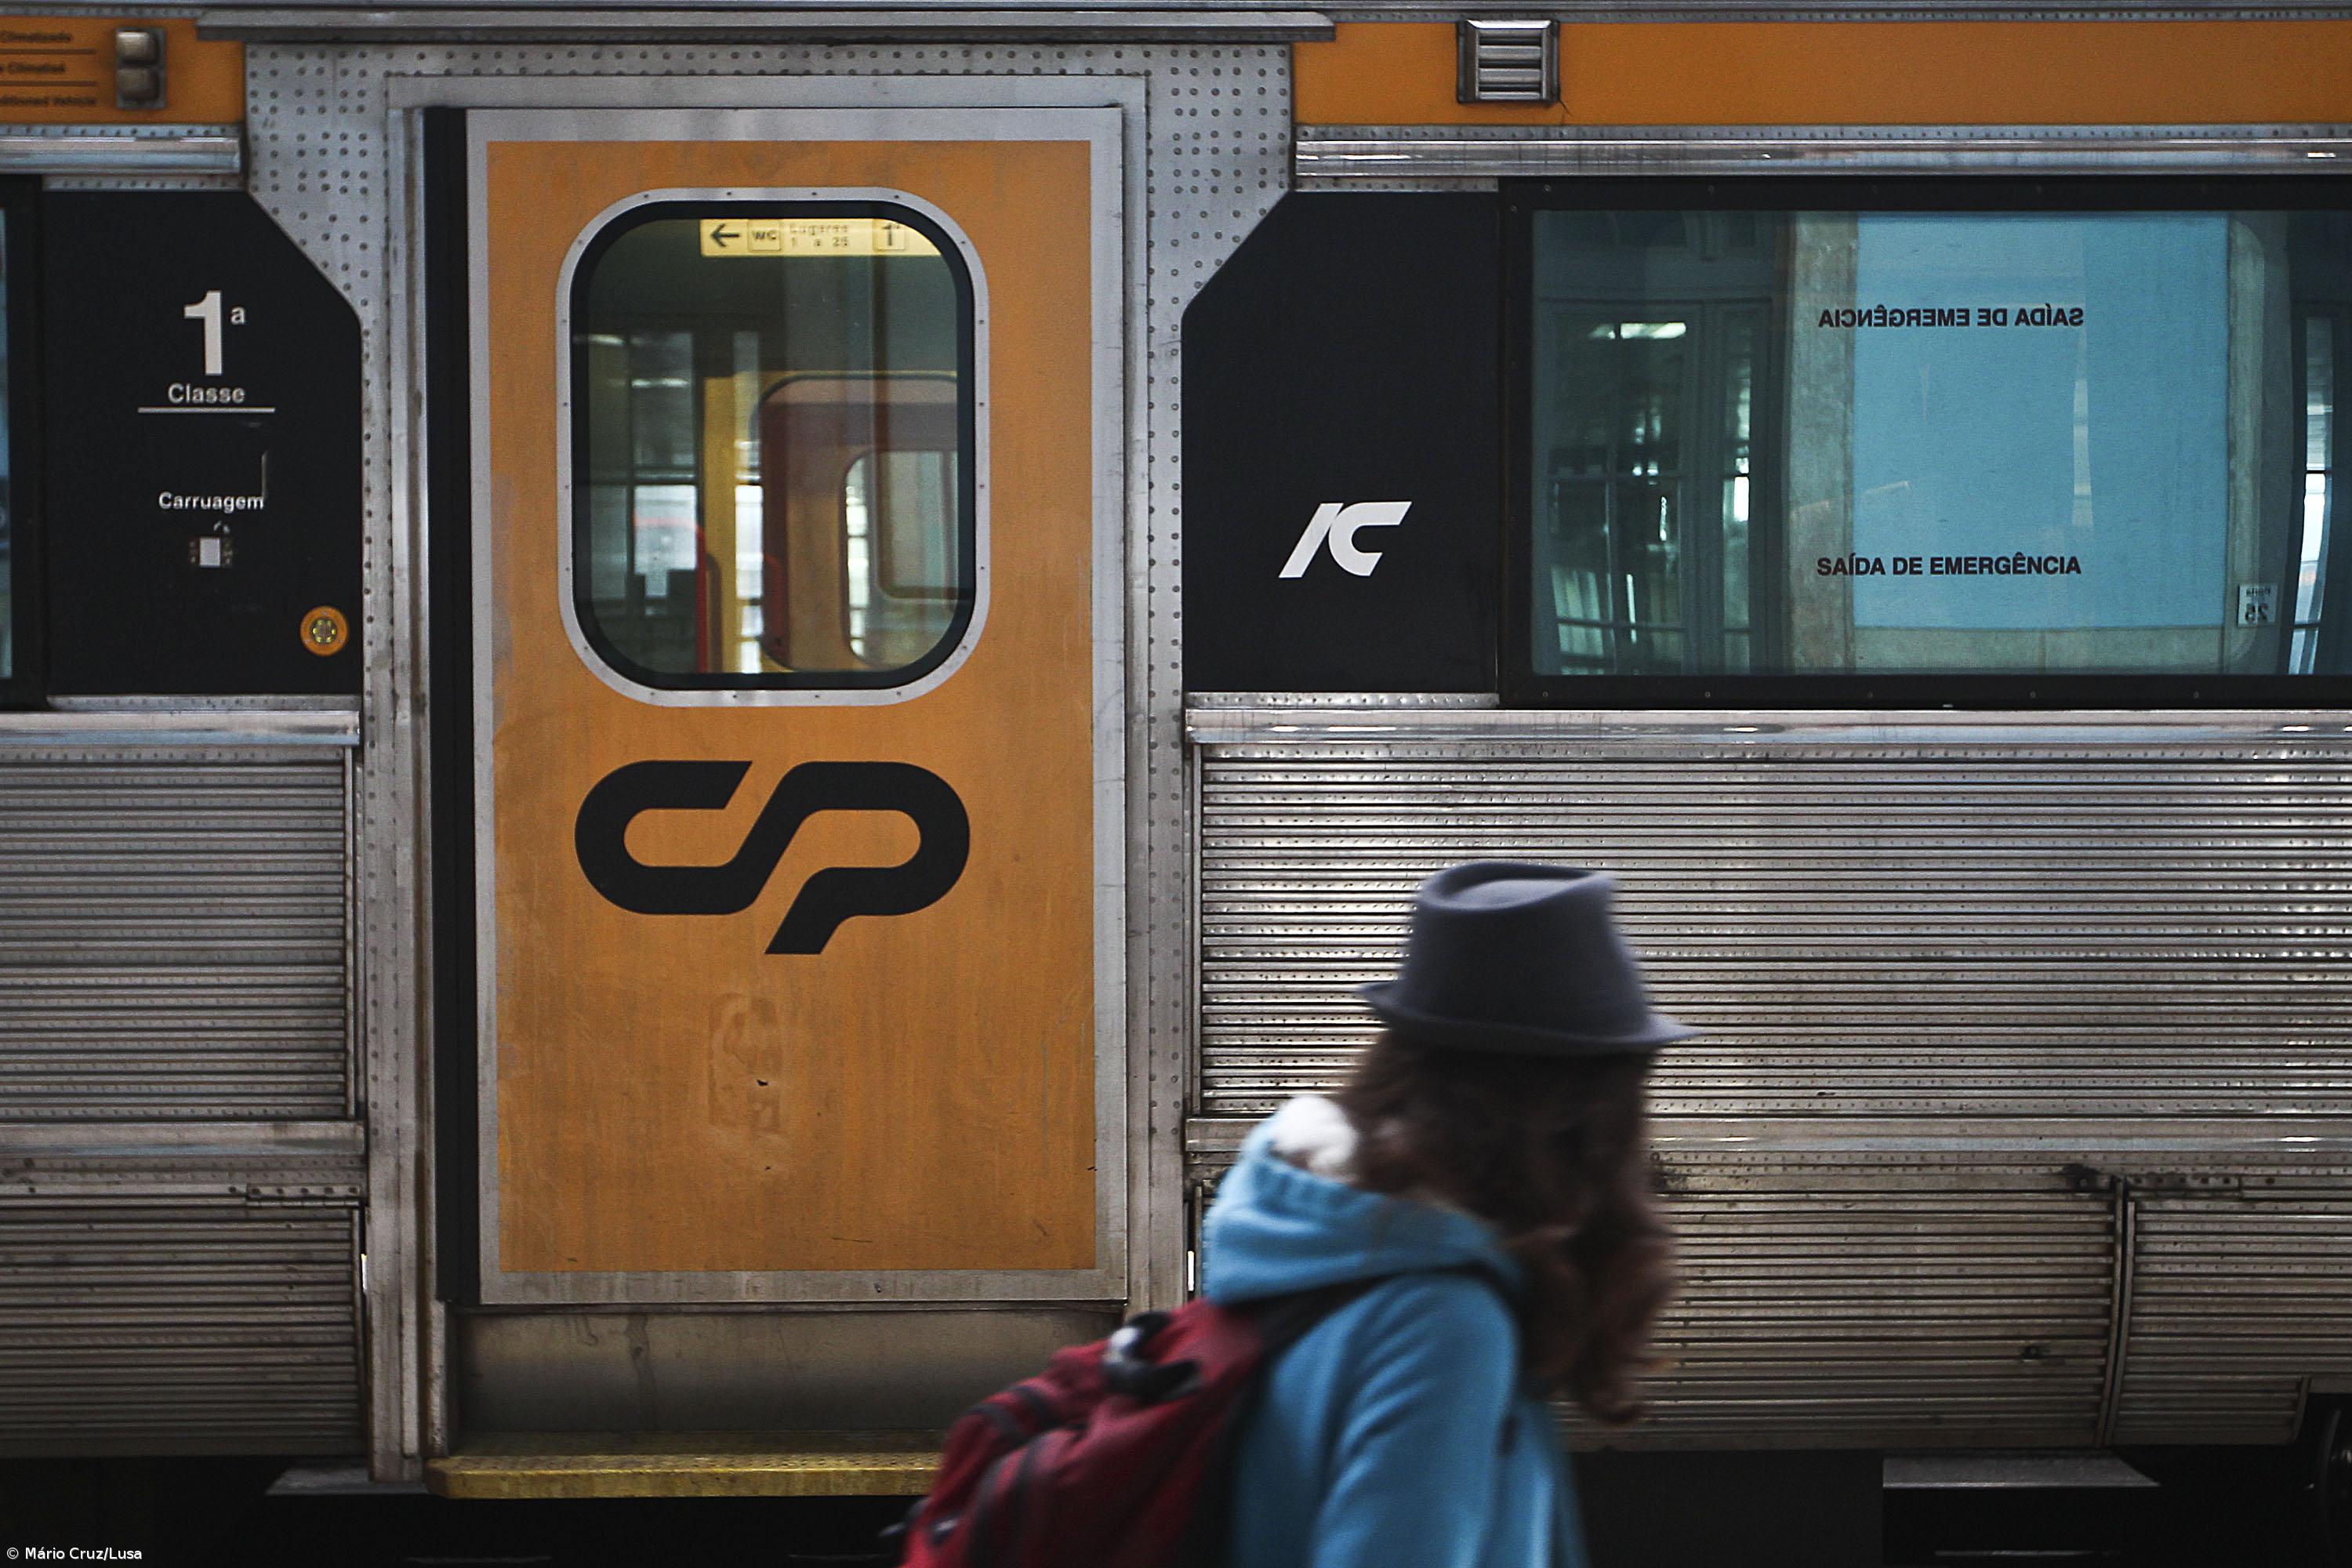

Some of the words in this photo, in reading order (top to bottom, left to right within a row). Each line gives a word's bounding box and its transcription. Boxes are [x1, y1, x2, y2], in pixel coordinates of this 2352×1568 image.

[751, 230, 777, 241] WC
[789, 223, 850, 236] Lugares
[168, 383, 245, 404] Classe
[158, 491, 264, 514] Carruagem
[1817, 552, 1886, 576] SAÍDA
[1893, 557, 1923, 575] DE
[1930, 551, 2082, 575] EMERGÊNCIA
[575, 760, 971, 955] CP
